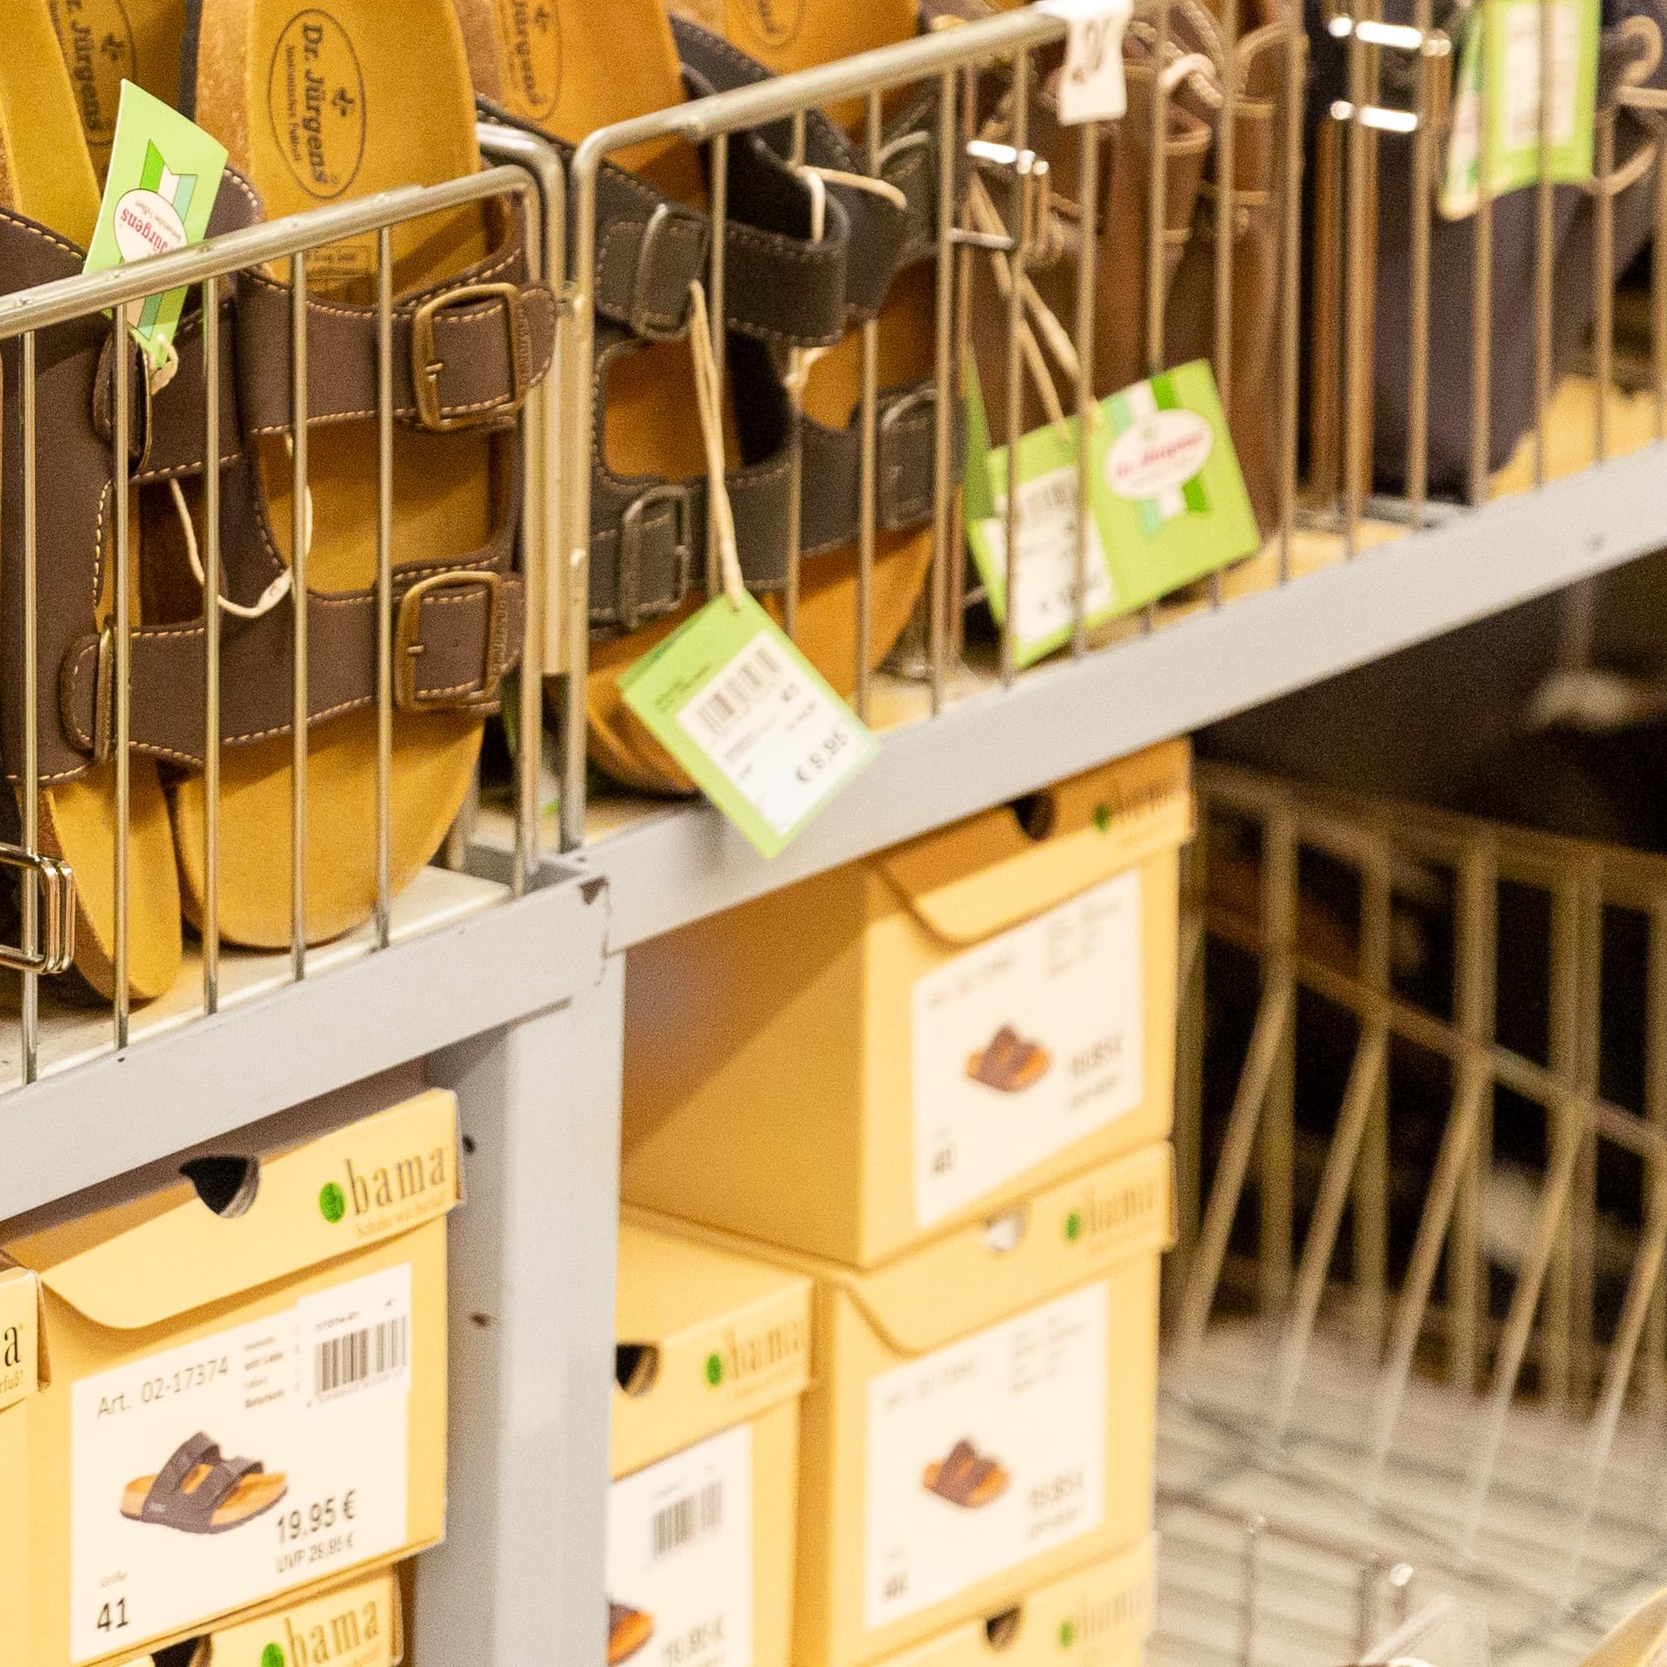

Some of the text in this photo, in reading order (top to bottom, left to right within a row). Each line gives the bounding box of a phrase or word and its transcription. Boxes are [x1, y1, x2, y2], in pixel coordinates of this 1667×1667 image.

[302, 22, 328, 184] Dr. Jürgens
[343, 1147, 446, 1217] bama
[97, 1394, 132, 1419] Art.
[140, 1355, 230, 1405] 02-17374
[343, 1489, 357, 1521] €
[96, 1597, 129, 1634] 41
[283, 1600, 380, 1667] bama
